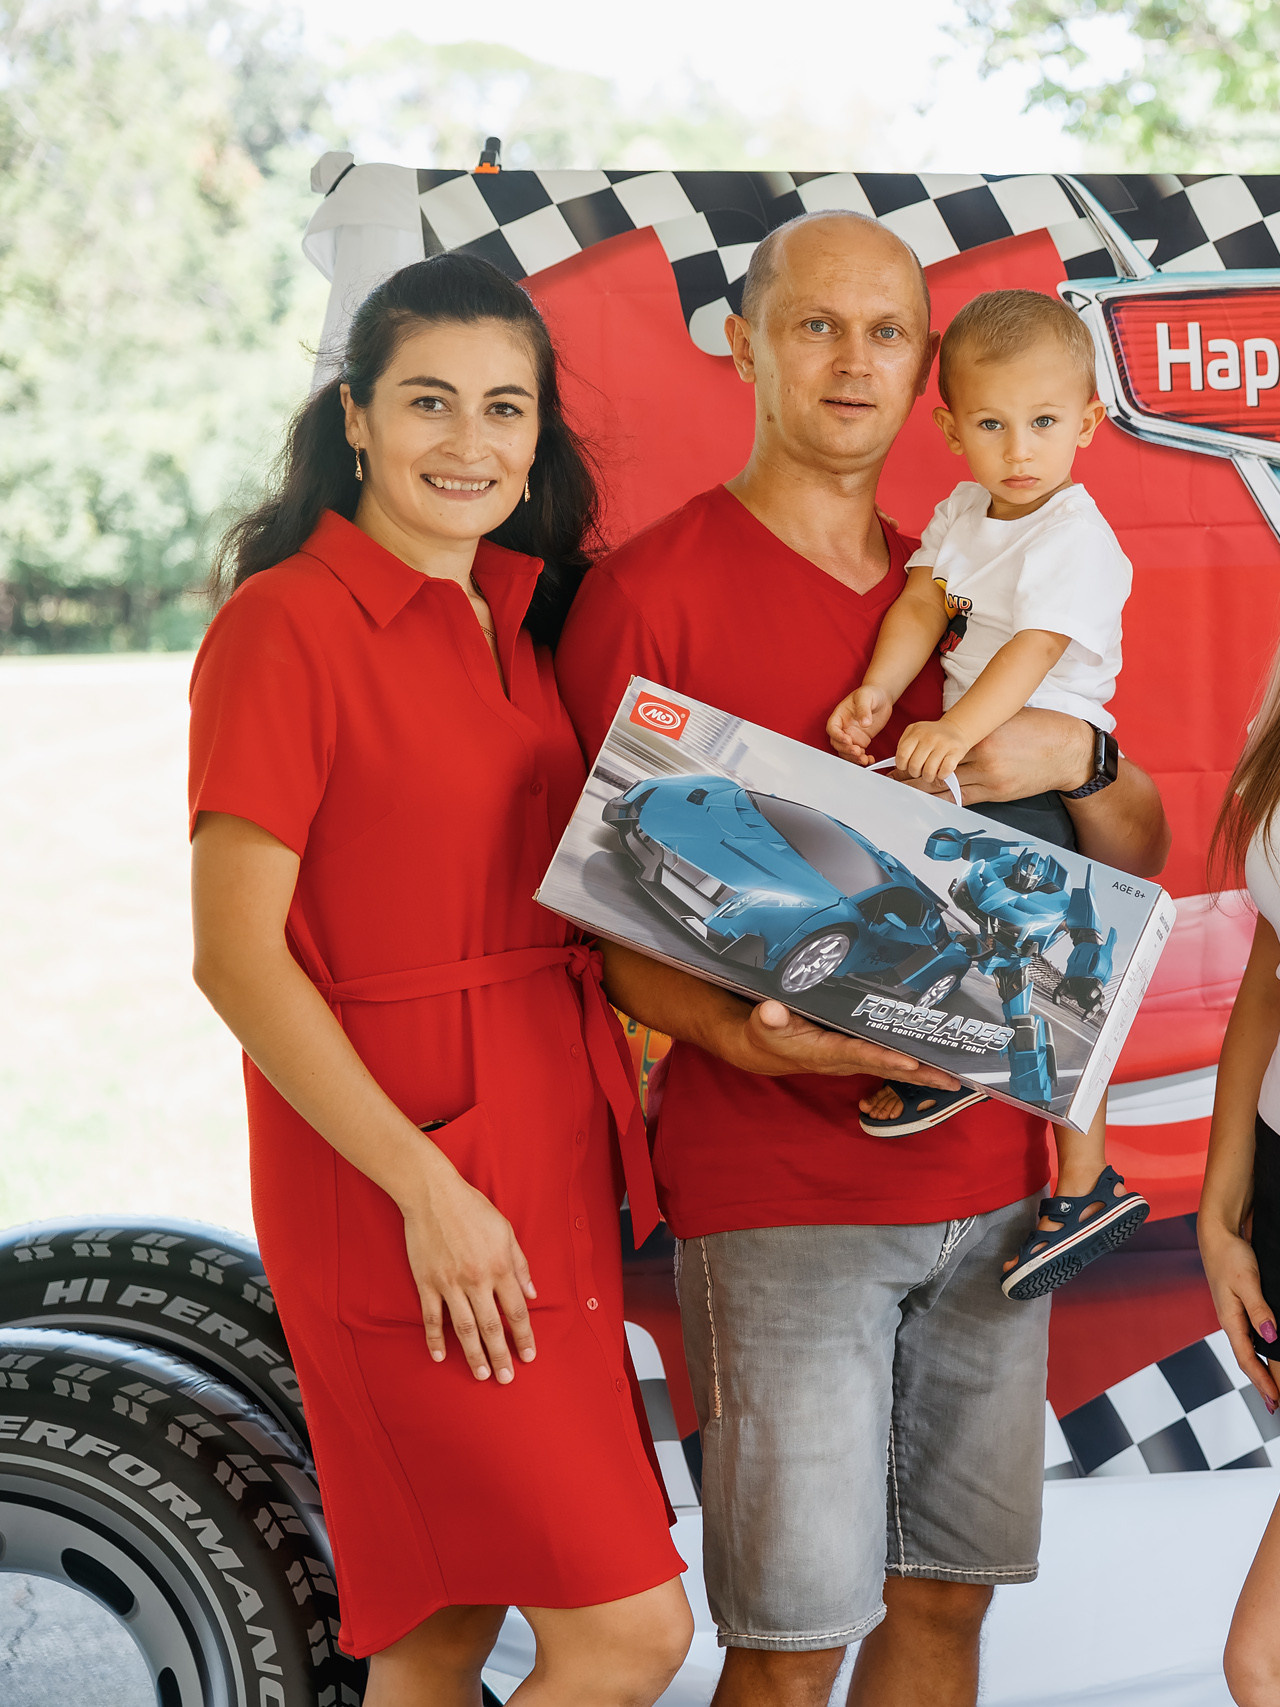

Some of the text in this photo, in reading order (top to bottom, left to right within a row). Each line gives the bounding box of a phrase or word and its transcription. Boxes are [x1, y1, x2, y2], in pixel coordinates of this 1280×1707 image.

[1112, 881, 1146, 899] AGE 8+
[851, 994, 1015, 1051] FORCE ARES
[866, 1020, 987, 1055] radio control deform robot
[42, 1277, 305, 1407] HI PERFO
